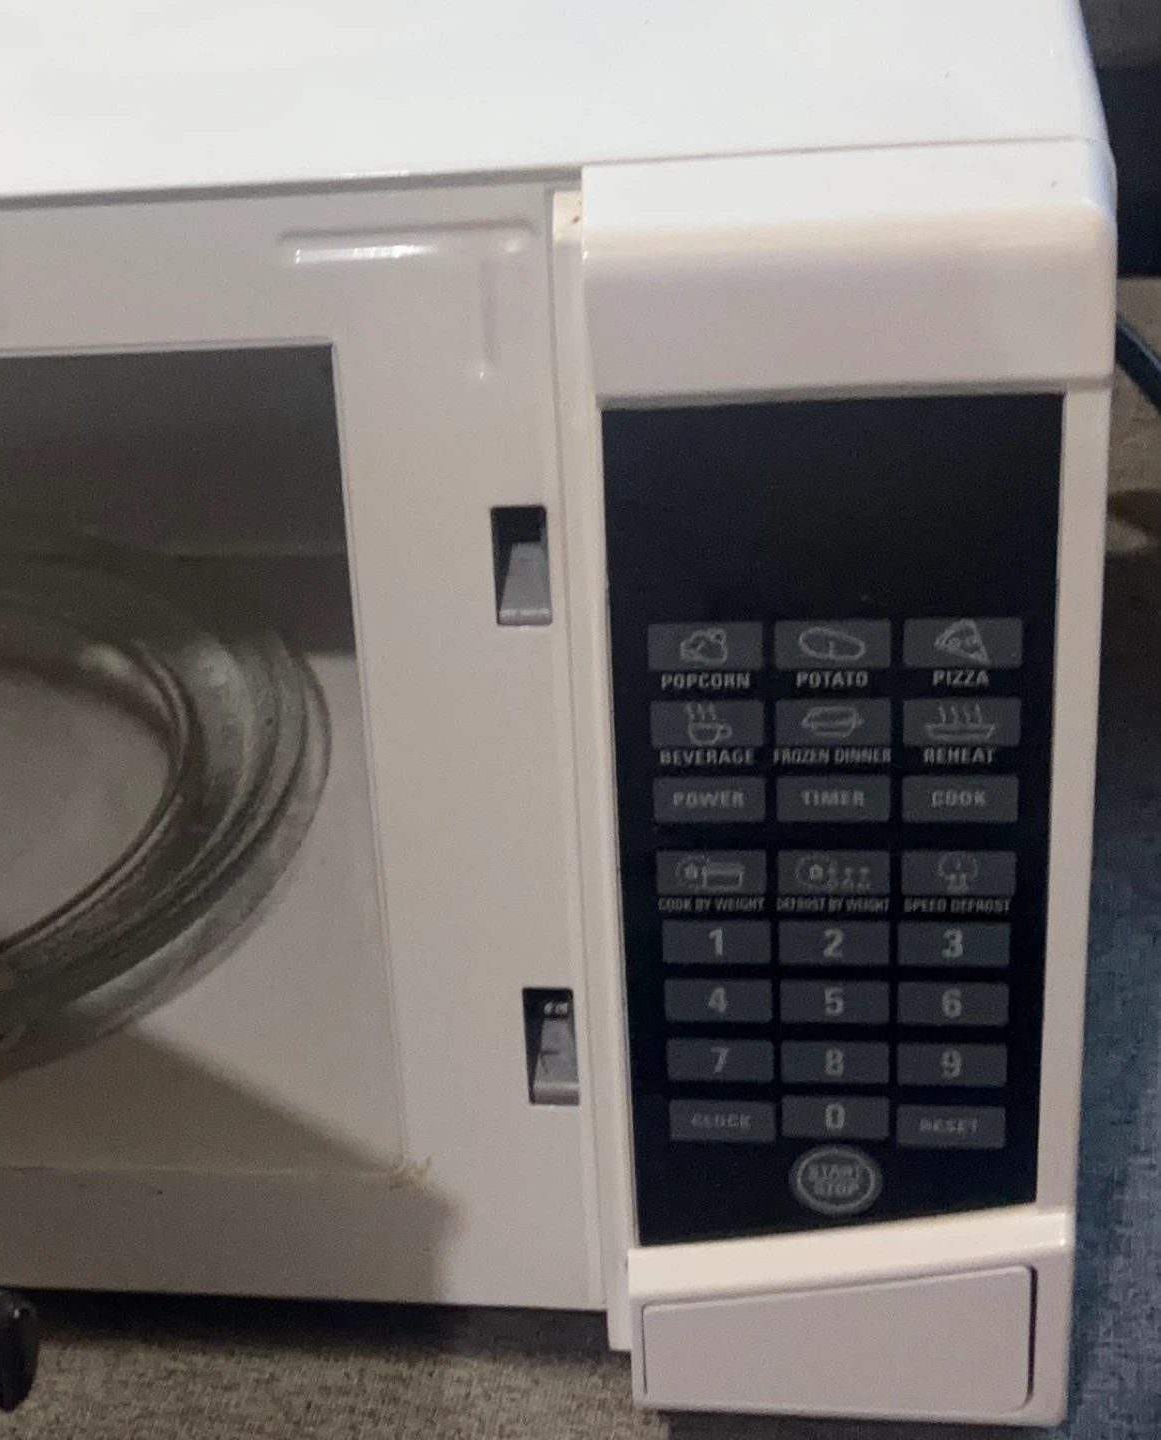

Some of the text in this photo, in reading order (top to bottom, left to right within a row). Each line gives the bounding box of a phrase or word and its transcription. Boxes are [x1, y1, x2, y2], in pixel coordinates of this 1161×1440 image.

[660, 671, 751, 691] POPCORN
[795, 670, 869, 689] POTATO
[931, 668, 990, 688] PIZZA
[659, 747, 755, 766] BEVERAGE
[773, 747, 892, 765] FROZEN DINNER
[923, 747, 995, 765] REHEAT
[672, 790, 745, 808] POWER
[800, 789, 865, 807] TIMER
[931, 789, 987, 808] COOK
[657, 896, 766, 911] COOK BY WEIGHT
[776, 896, 890, 912] DEFROST BY WEIGHT
[903, 897, 1011, 913] SPEED DEFROST
[708, 928, 724, 957] 1
[822, 928, 844, 959] 2
[941, 928, 964, 960] 3
[707, 986, 728, 1014] 4
[823, 986, 845, 1017] 5
[942, 987, 963, 1019] 6
[709, 1046, 730, 1074] 7
[823, 1047, 845, 1078] 8
[941, 1047, 962, 1079] 9
[689, 1113, 751, 1131] CLOCK
[824, 1103, 846, 1131] 0
[918, 1117, 979, 1134] RESET
[807, 1164, 860, 1181] START
[813, 1180, 861, 1197] STOP
